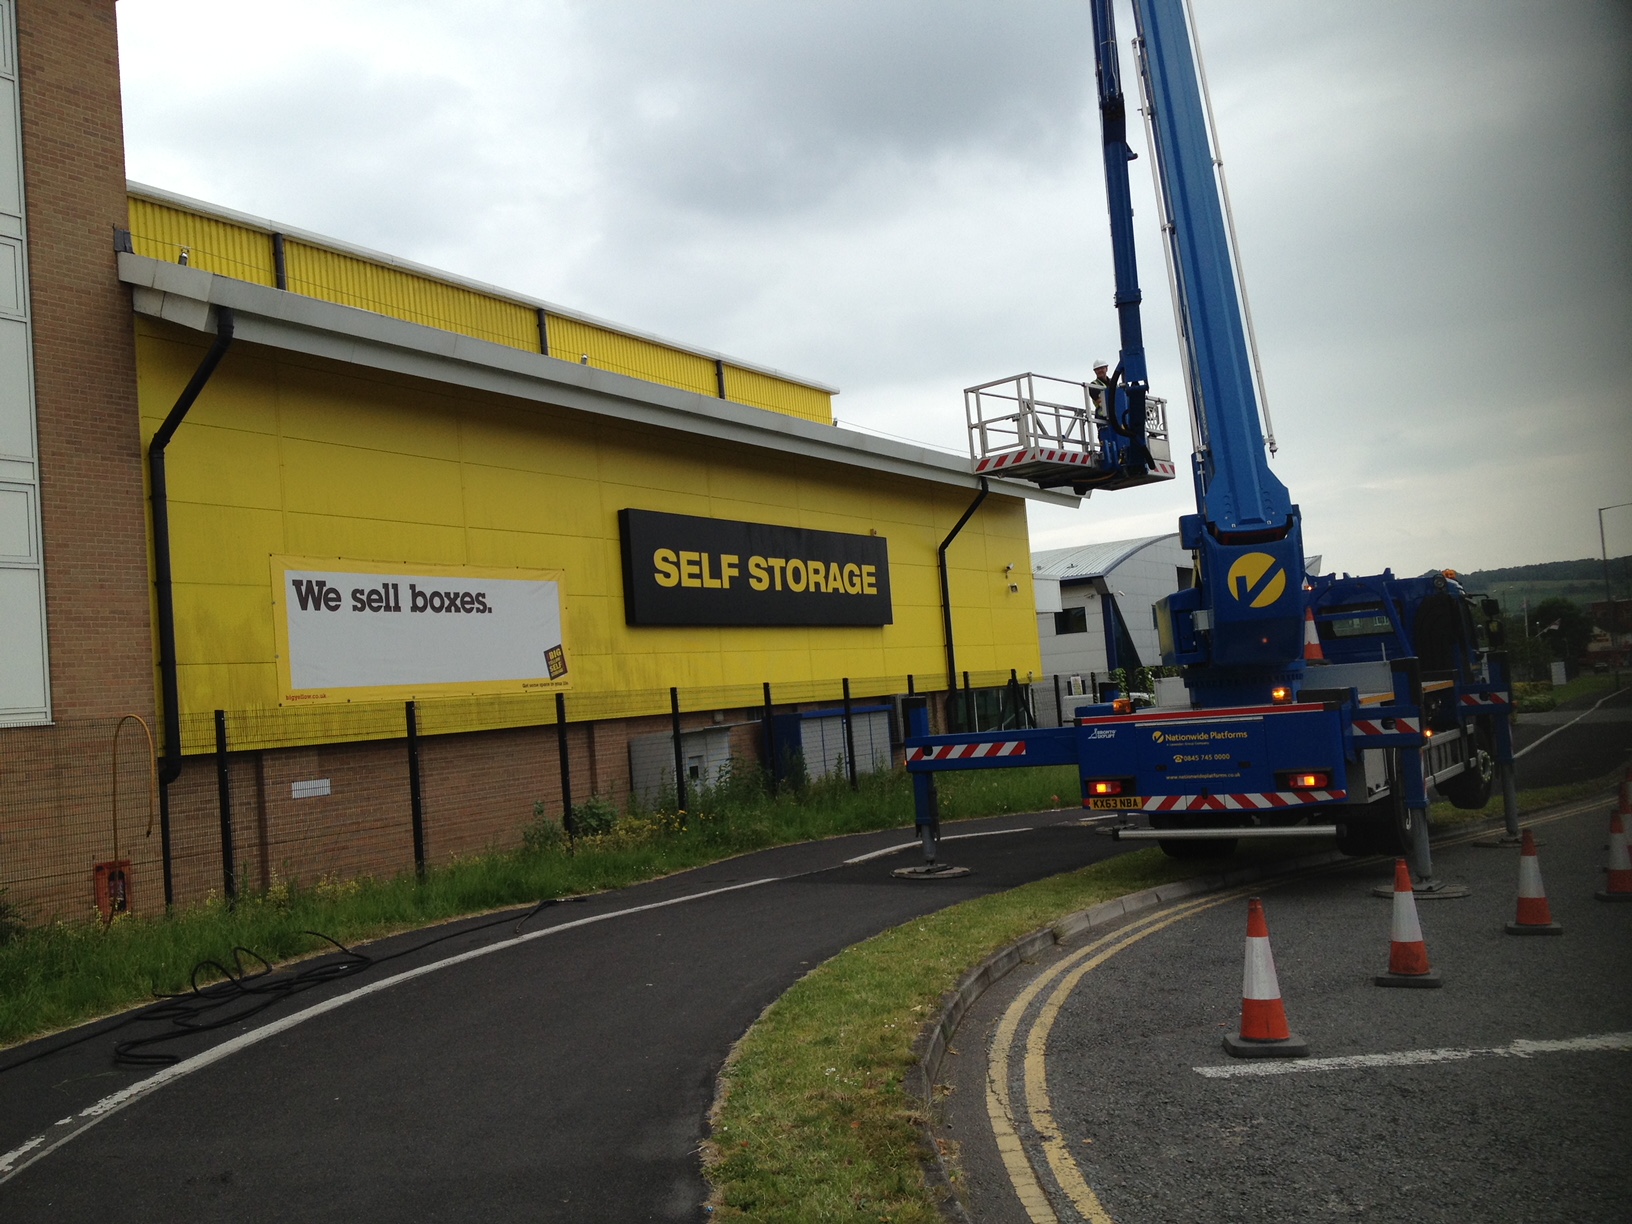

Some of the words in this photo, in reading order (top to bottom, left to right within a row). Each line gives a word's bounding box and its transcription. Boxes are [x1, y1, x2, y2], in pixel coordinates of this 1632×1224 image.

[653, 548, 739, 589] SELF
[748, 555, 878, 595] STORAGE
[292, 579, 342, 612] We
[351, 583, 401, 612] sell
[409, 583, 493, 614] boxes.
[549, 648, 562, 660] BIG
[285, 693, 327, 701] bigyellow.co.uk
[1165, 732, 1209, 741] Nationwide
[1210, 731, 1248, 739] Platforms
[1093, 798, 1118, 808] KX63
[1119, 797, 1139, 808] NBA
